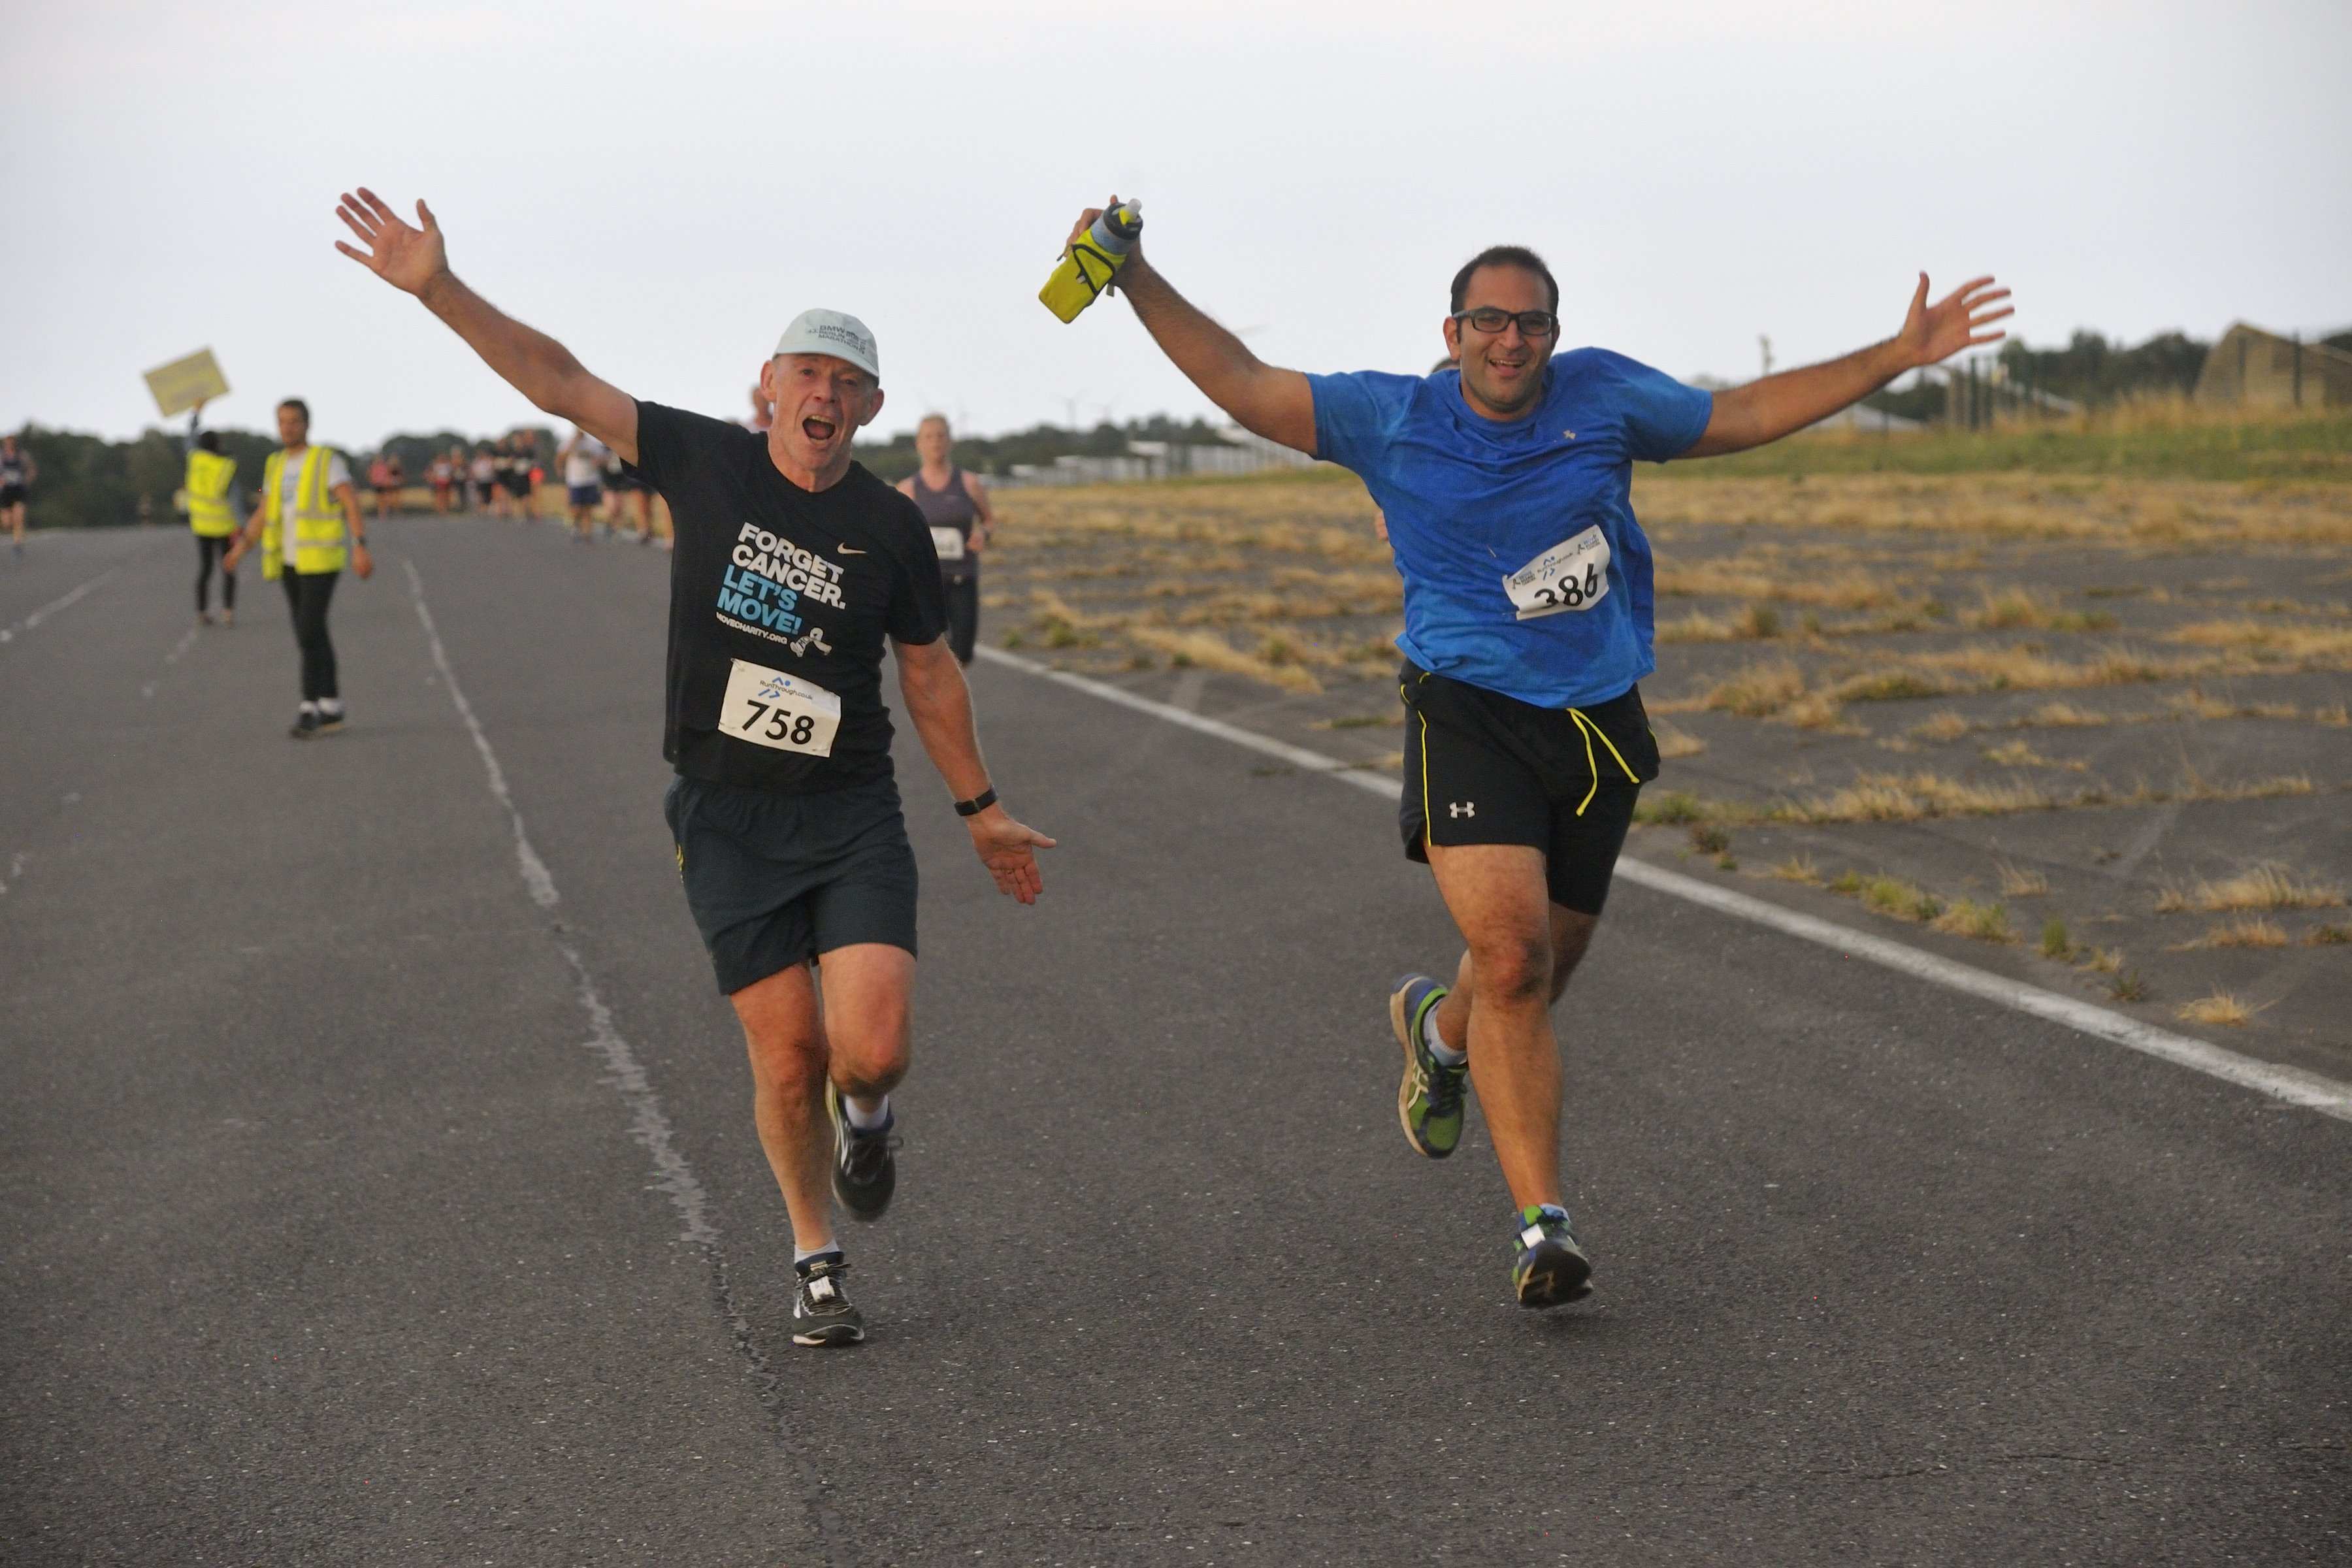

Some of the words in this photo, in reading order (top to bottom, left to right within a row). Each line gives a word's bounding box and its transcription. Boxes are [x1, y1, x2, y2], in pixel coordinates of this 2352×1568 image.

[738, 522, 844, 583] FORGET
[723, 564, 797, 611] LET'S
[732, 544, 846, 610] CANCER.
[1535, 563, 1598, 608] 386
[716, 612, 787, 644] MOVECHARITY.ORG
[717, 587, 802, 635] MOVE!
[760, 680, 813, 700] RunThrough.co.uk
[742, 699, 814, 745] 758
